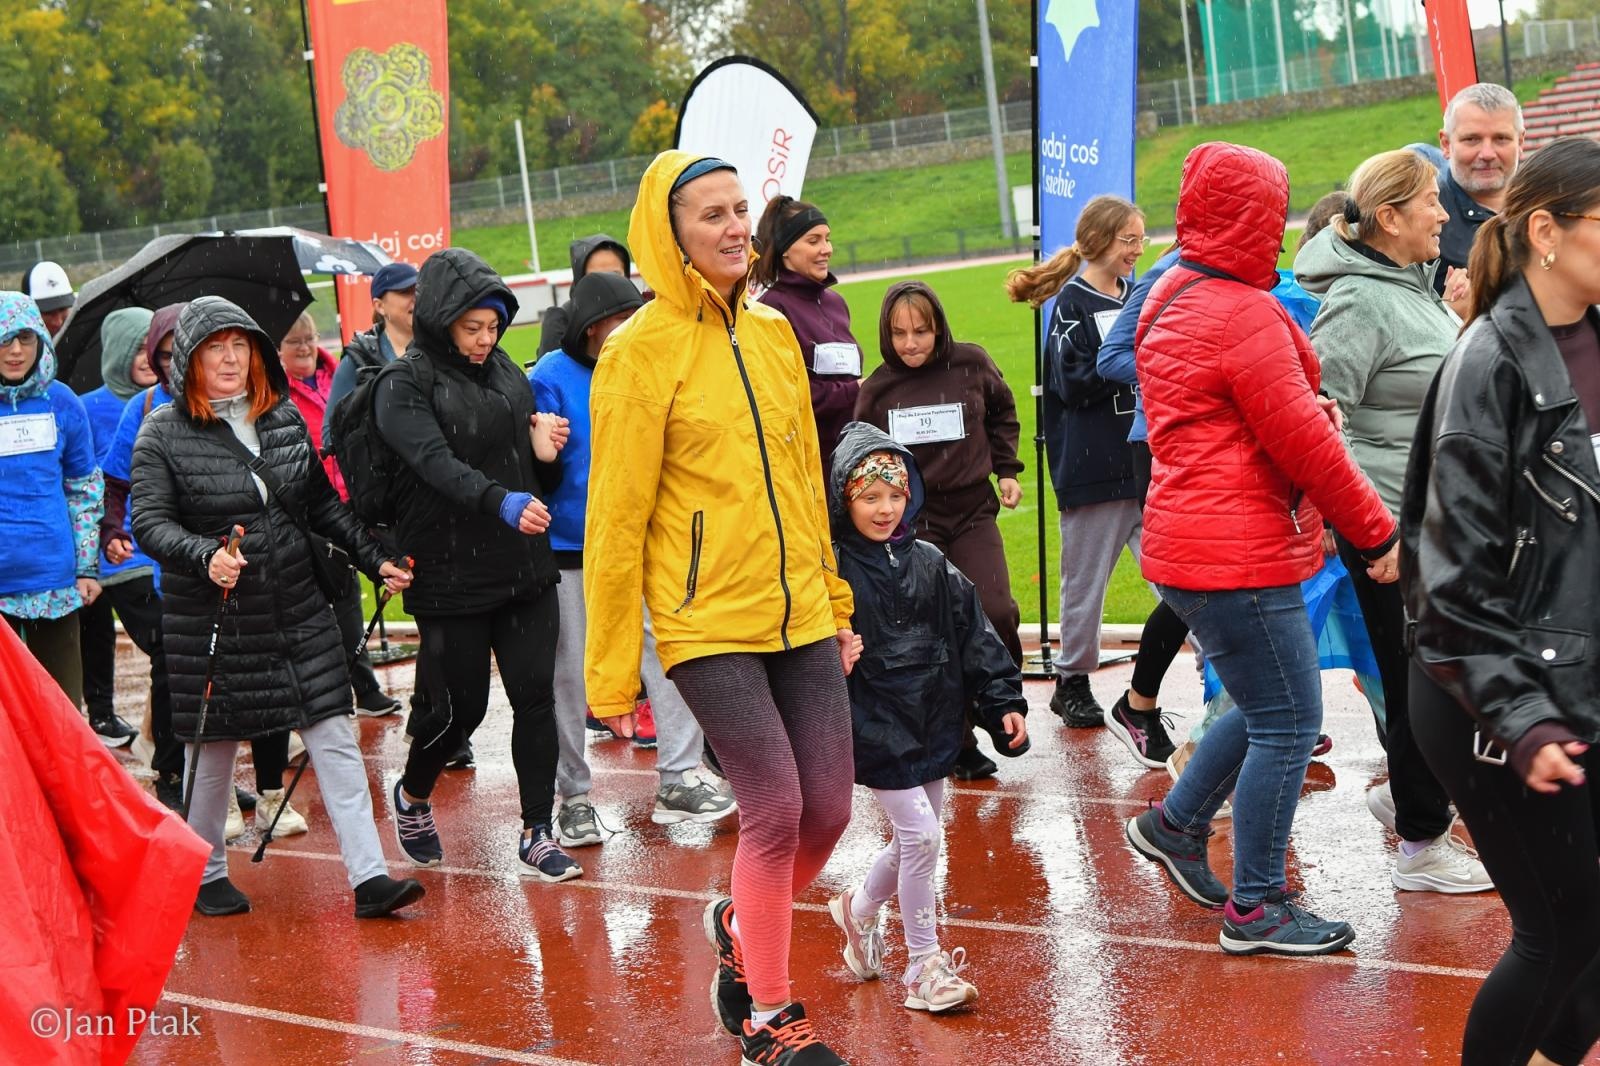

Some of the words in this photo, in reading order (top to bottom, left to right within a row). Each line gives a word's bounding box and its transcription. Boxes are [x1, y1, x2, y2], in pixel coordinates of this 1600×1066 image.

[1041, 131, 1066, 168] odaj
[1070, 138, 1099, 165] coś
[1045, 168, 1075, 198] siebie
[920, 417, 932, 428] 19
